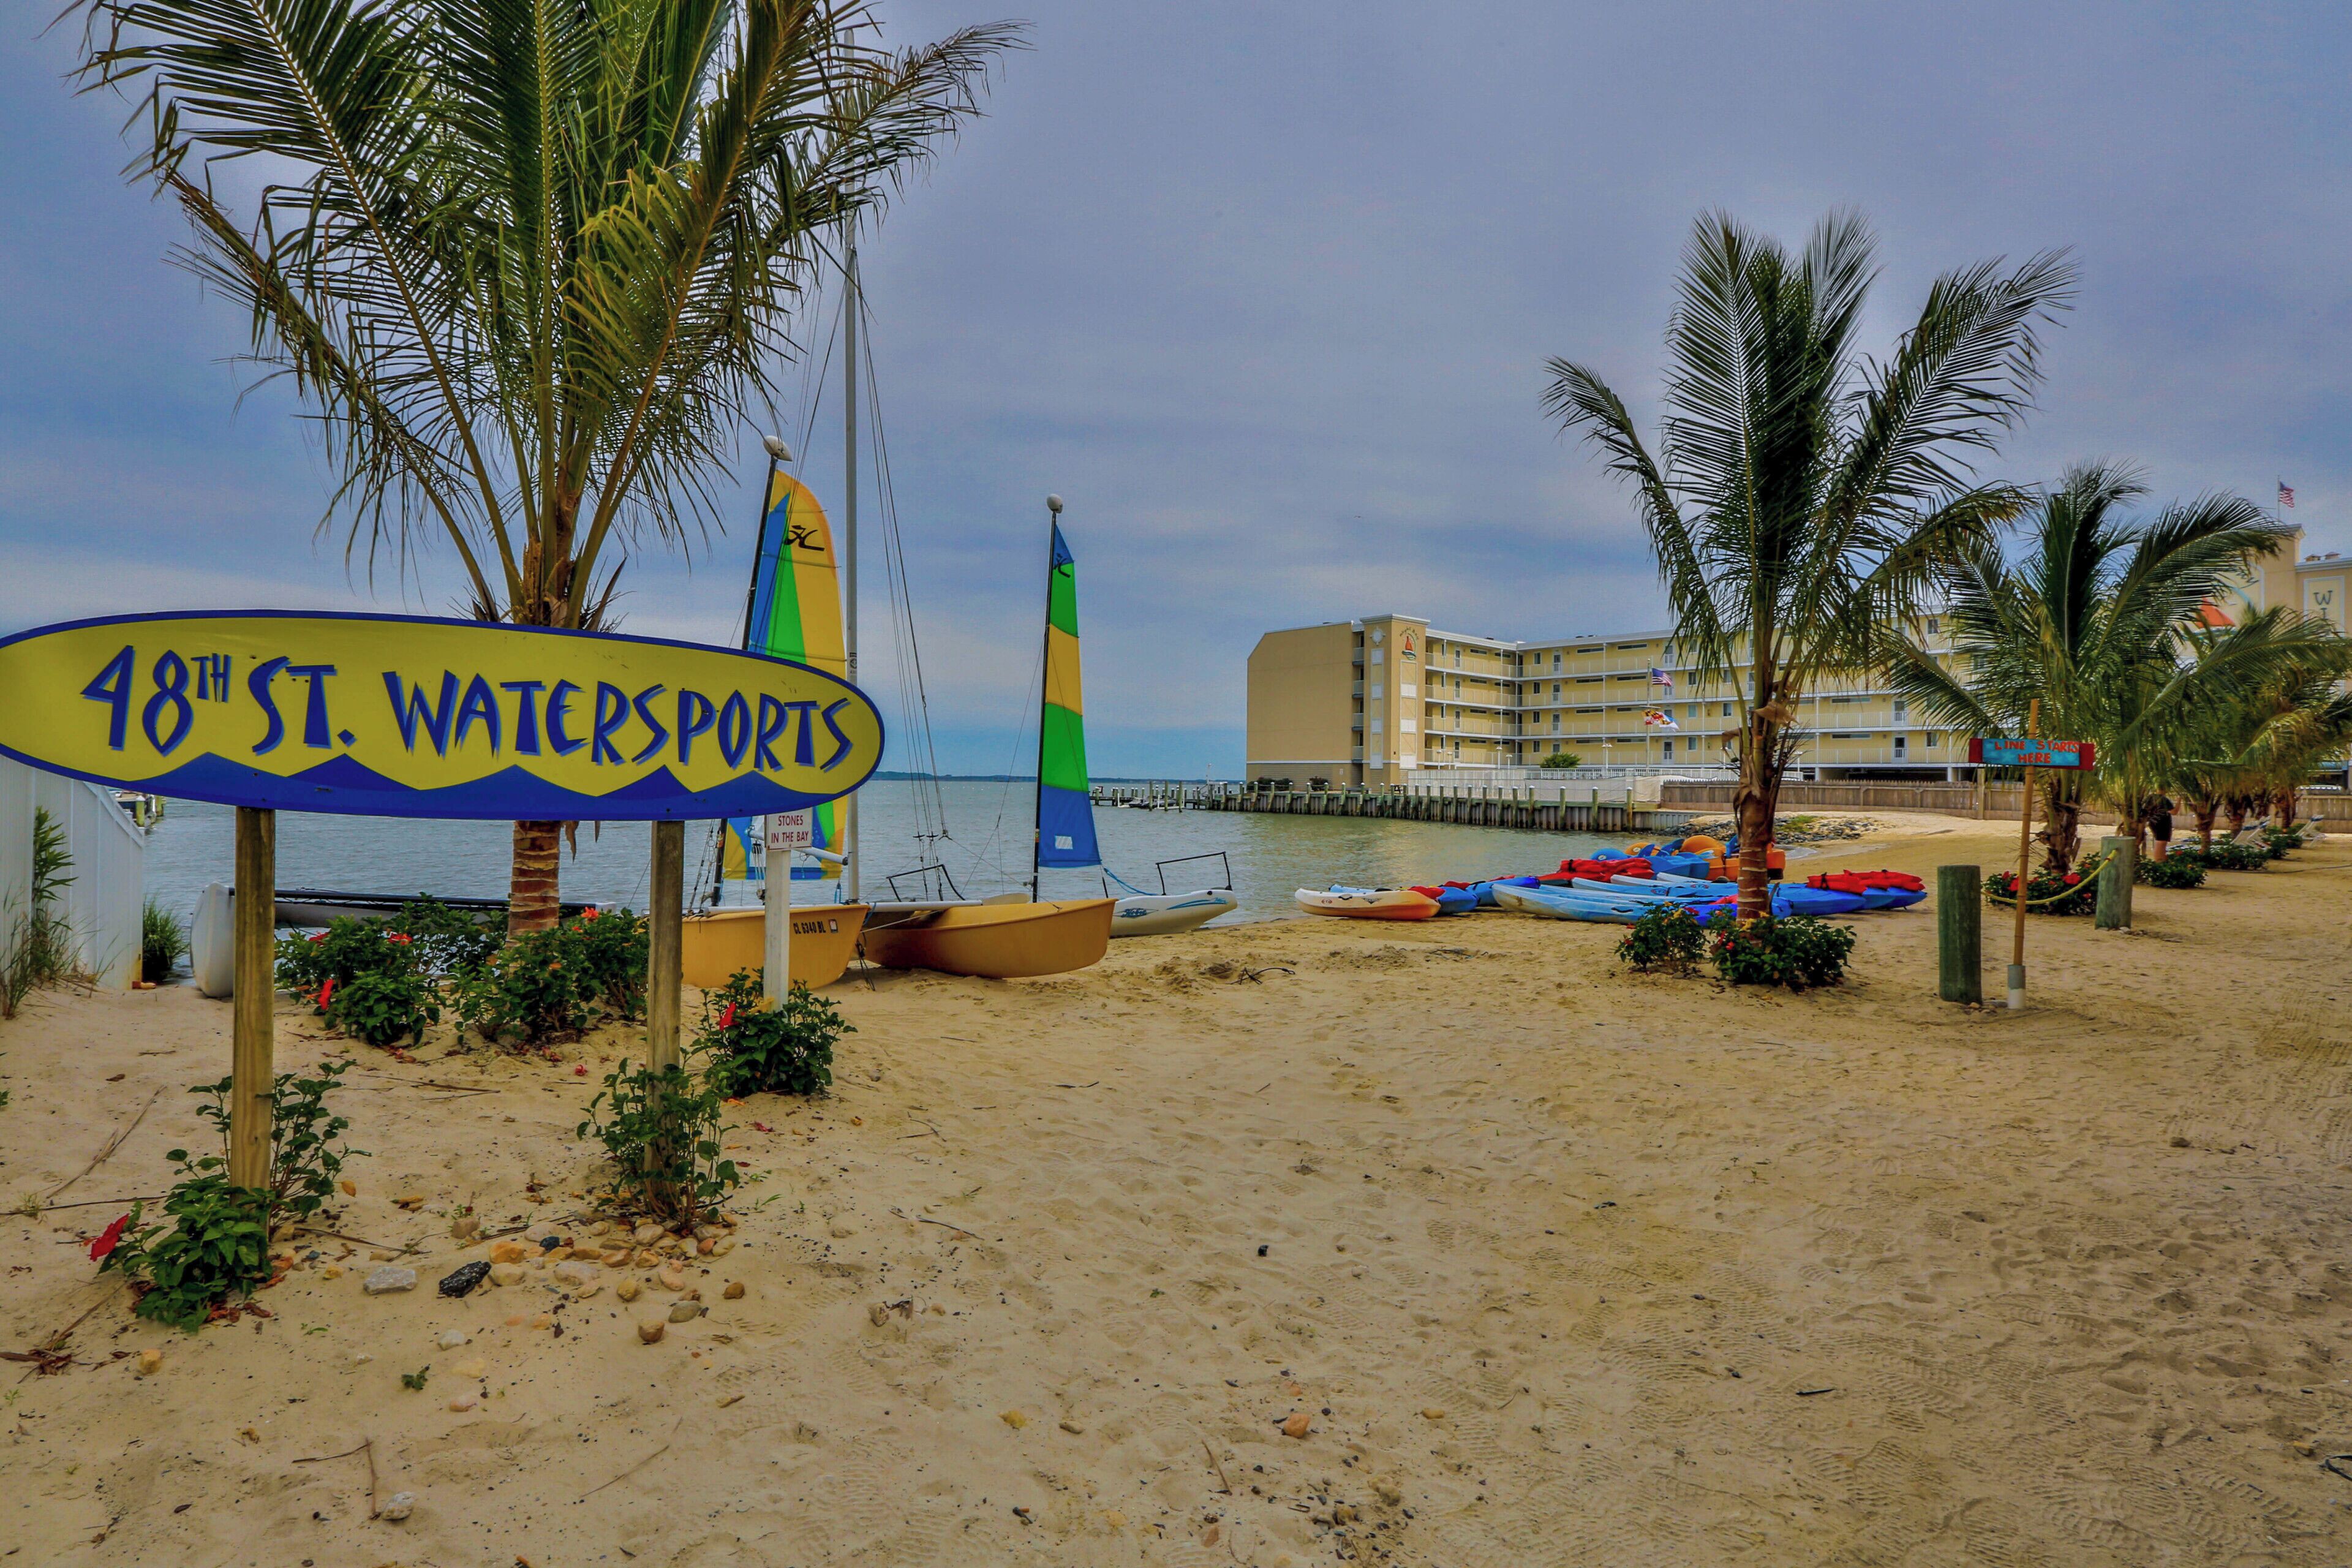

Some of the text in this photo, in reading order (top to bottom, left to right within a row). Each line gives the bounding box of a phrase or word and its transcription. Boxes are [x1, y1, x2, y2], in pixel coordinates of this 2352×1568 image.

[81, 645, 853, 772] 48TH ST. WATERSPORTS
[1995, 739, 2080, 753] LINE STARTS
[2018, 752, 2051, 764] HERE
[778, 815, 804, 826] STONES
[771, 831, 809, 843] IN THE BAY
